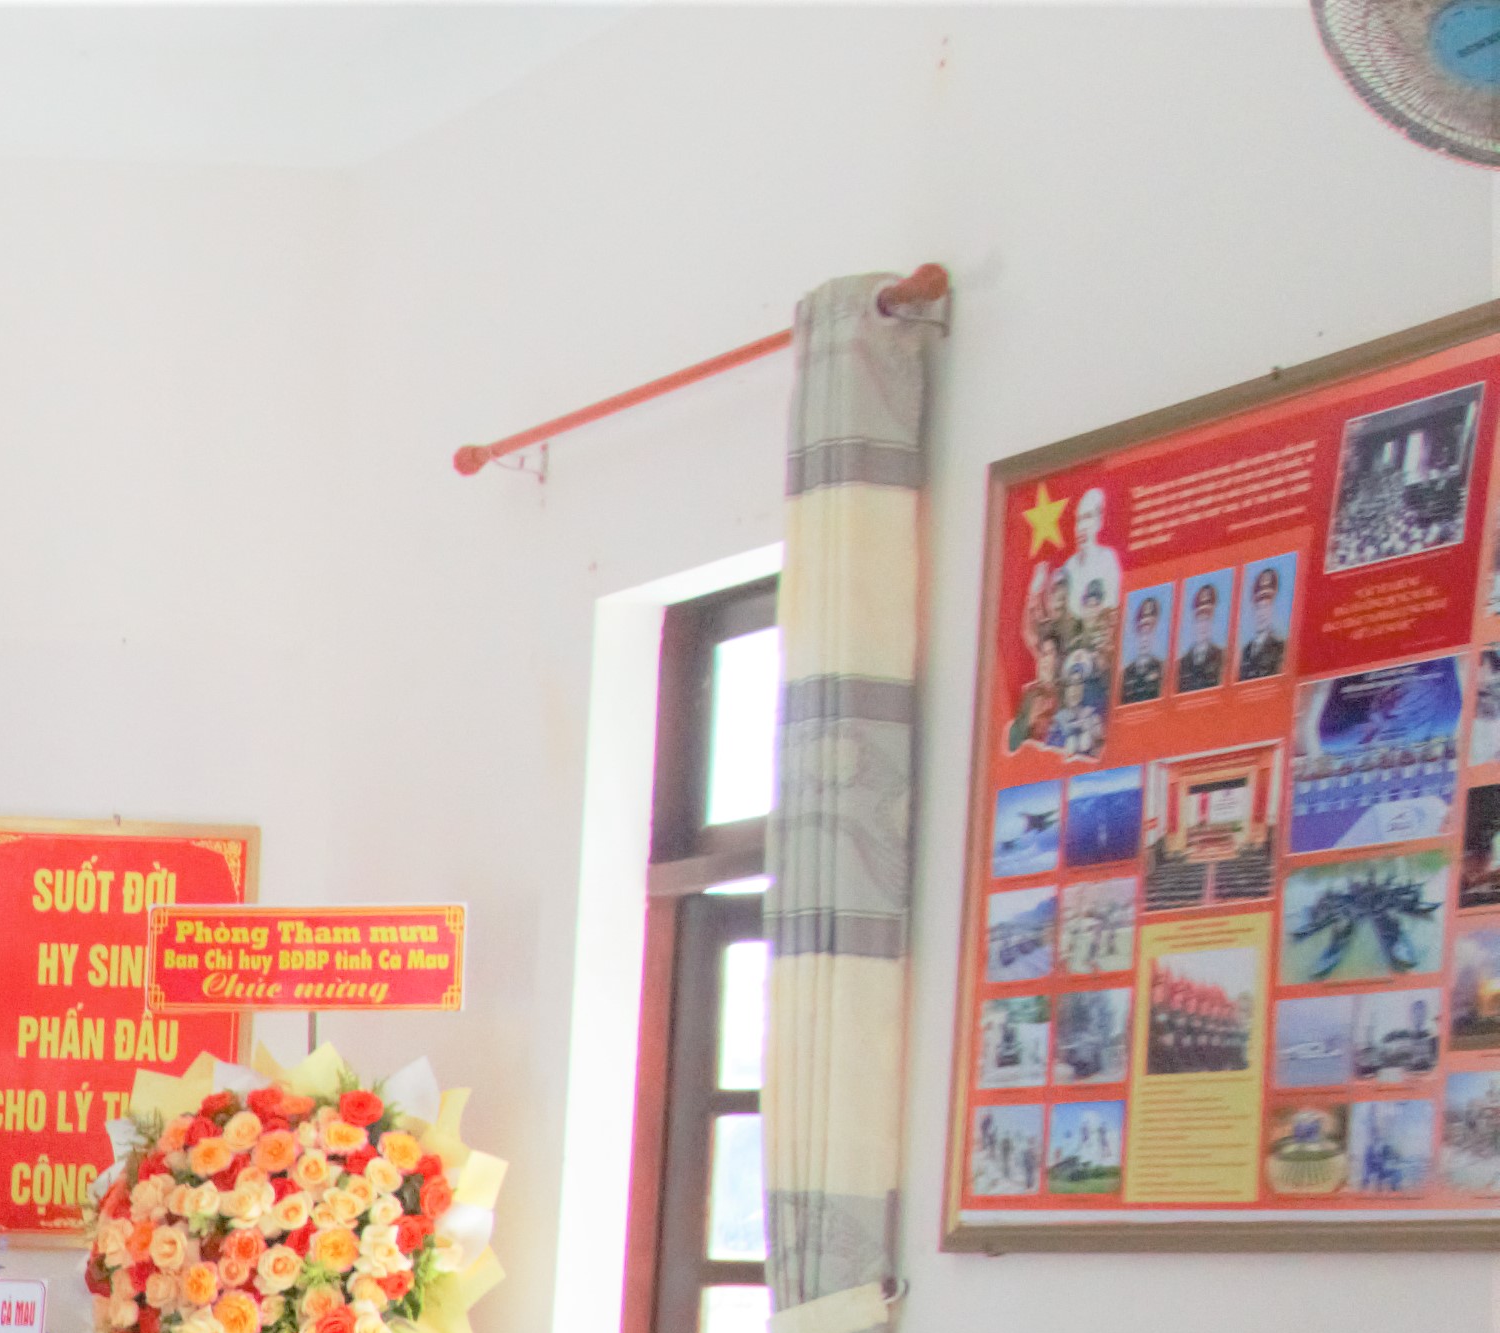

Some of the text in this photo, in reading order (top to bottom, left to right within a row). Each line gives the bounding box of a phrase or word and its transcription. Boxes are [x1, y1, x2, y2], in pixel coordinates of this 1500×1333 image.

[32, 855, 177, 914] SUỐT ĐỜI
[175, 920, 439, 950] Phòng Tham mưu
[38, 942, 148, 988] HY SIN
[163, 948, 450, 975] Ban Chỉ huy BĐBP tỉnh Cà Mau
[202, 971, 390, 1003] Chúc mừng
[17, 1001, 106, 1061] PHẤN
[56, 1081, 95, 1133] LÝ
